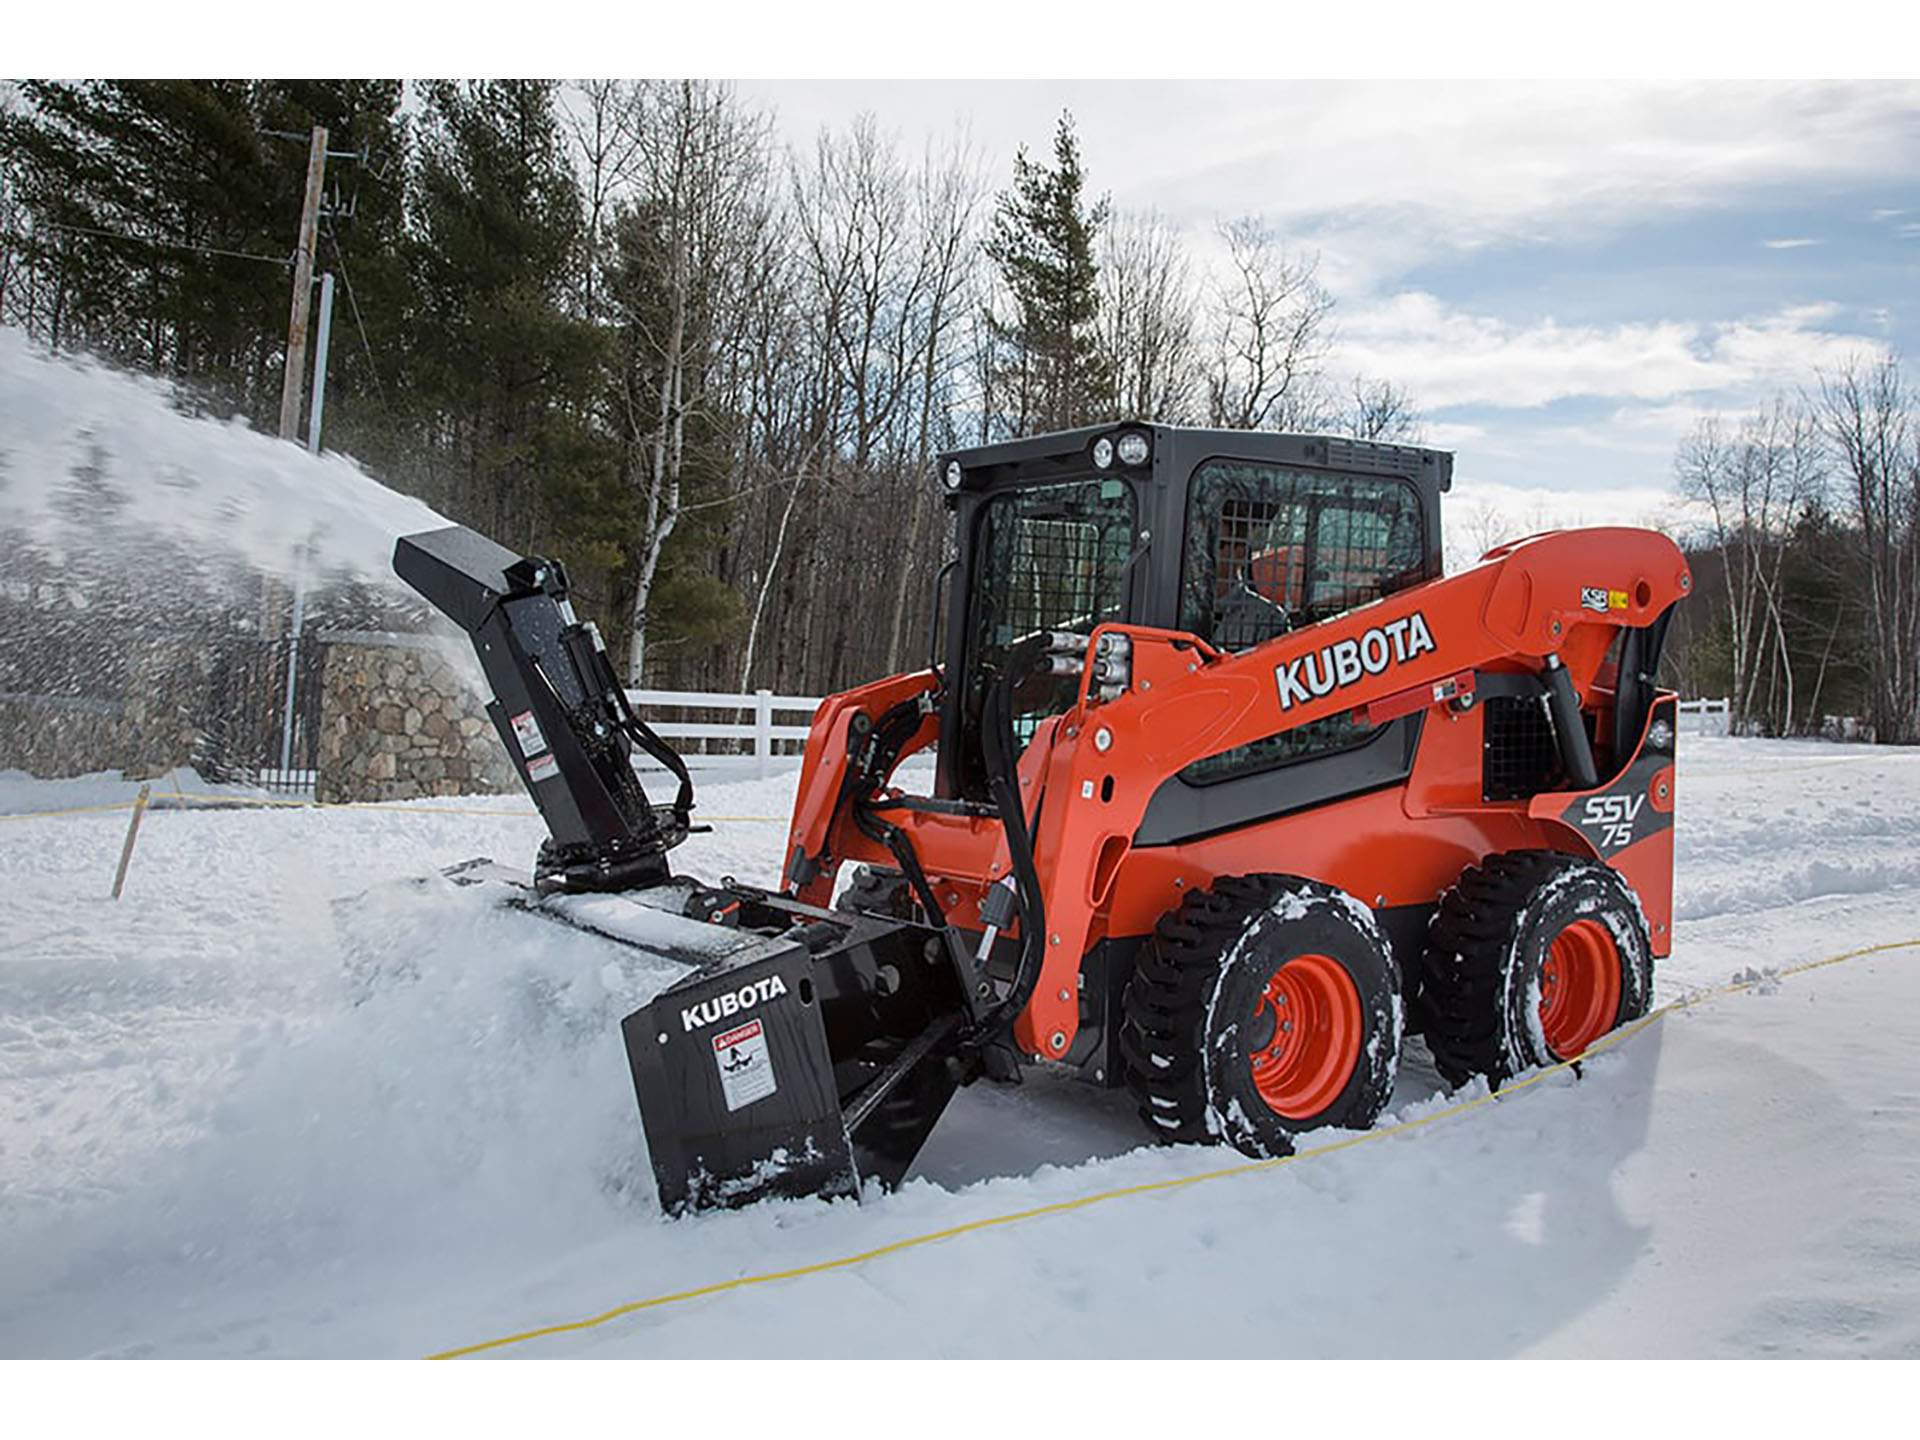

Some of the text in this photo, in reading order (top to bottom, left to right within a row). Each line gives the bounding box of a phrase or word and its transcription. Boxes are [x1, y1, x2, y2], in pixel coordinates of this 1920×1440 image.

[1276, 613, 1435, 708] KUBOTA
[1582, 794, 1645, 824] SSV
[1601, 823, 1633, 847] 75
[682, 975, 786, 1031] KUBOTA
